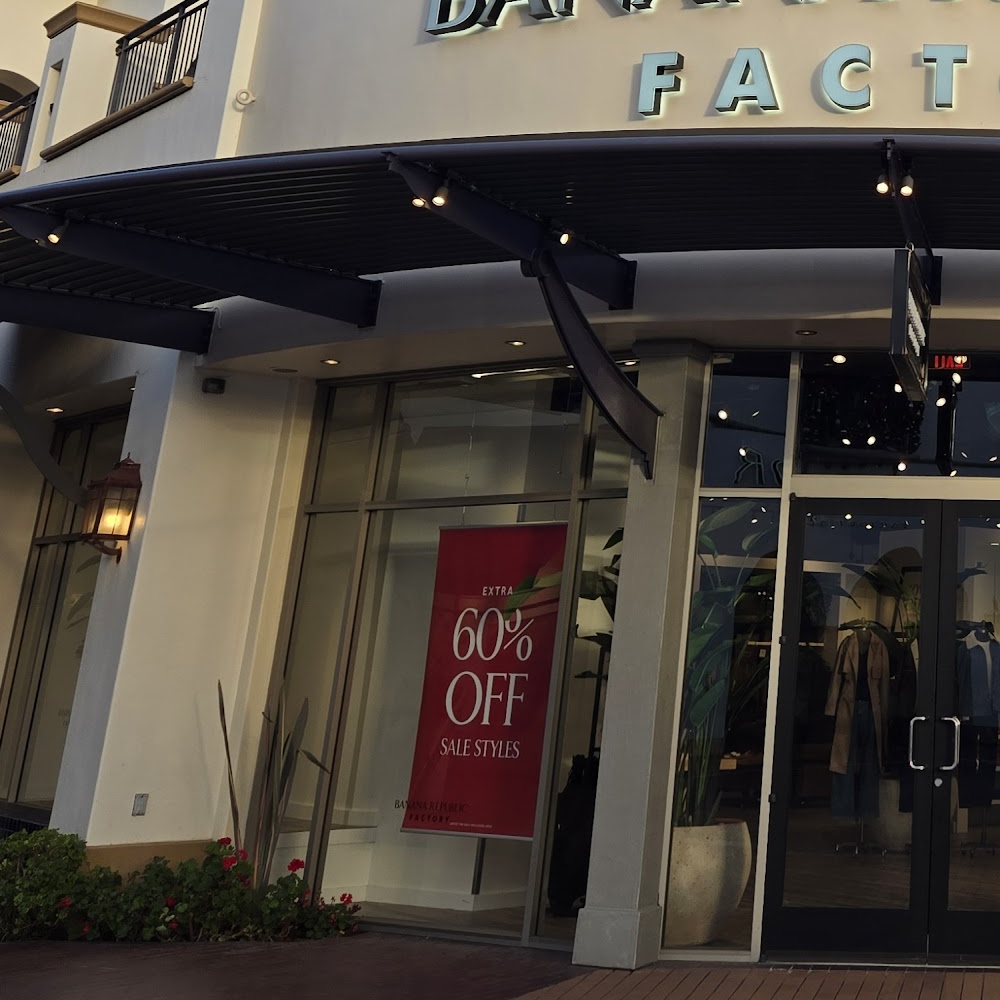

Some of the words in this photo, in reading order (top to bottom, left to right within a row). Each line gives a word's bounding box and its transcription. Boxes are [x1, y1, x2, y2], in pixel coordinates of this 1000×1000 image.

[482, 585, 514, 597] EXTRA
[452, 607, 534, 662] 60%
[445, 670, 529, 727] OFF
[439, 737, 471, 757] SALE
[474, 739, 521, 759] STYLES
